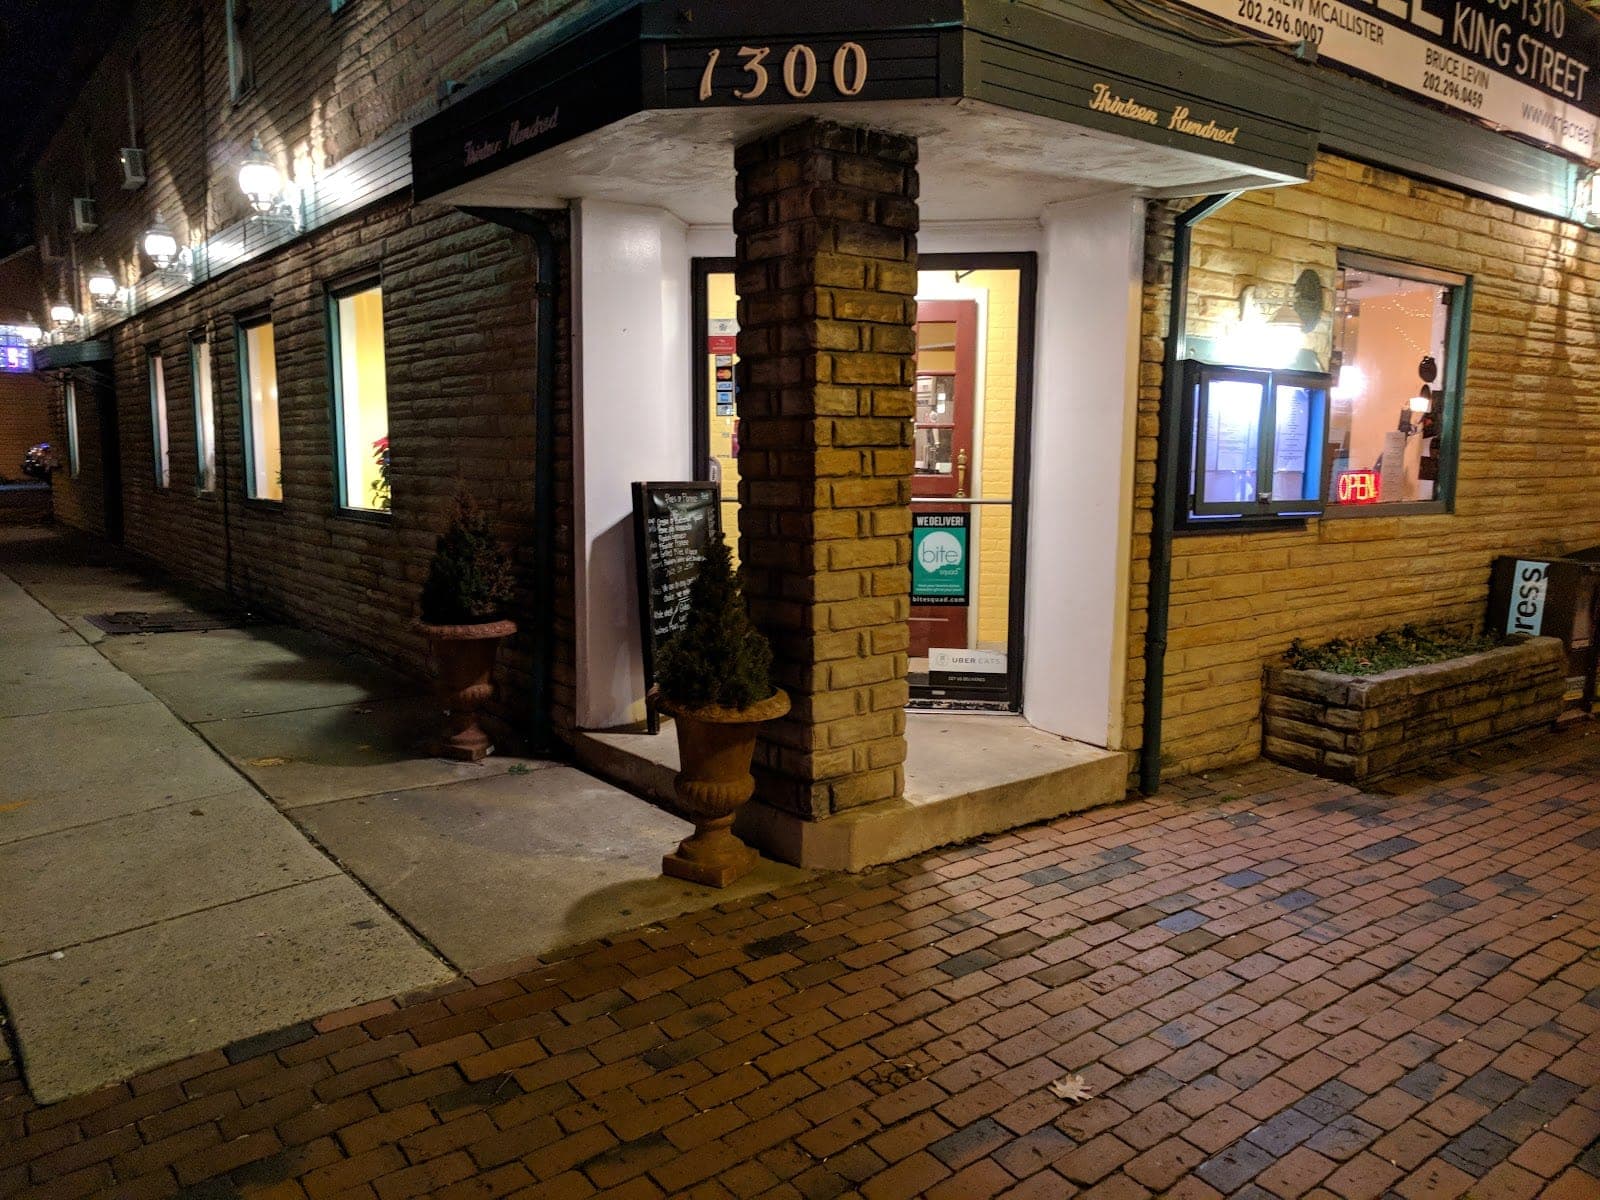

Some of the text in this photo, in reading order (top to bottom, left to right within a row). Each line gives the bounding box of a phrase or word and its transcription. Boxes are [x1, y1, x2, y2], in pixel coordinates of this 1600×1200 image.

[699, 41, 868, 101] 1300
[1425, 47, 1490, 90] BRUCE LEVIN
[1452, 1, 1512, 67] KING
[1515, 33, 1590, 101] STREET
[1088, 83, 1240, 145] Thirteen Hundred
[1338, 472, 1377, 500] OPEN
[916, 515, 964, 527] WE DELIVER!
[921, 541, 960, 564] bite
[912, 596, 966, 604] bitesquad.com
[1514, 567, 1542, 634] ress
